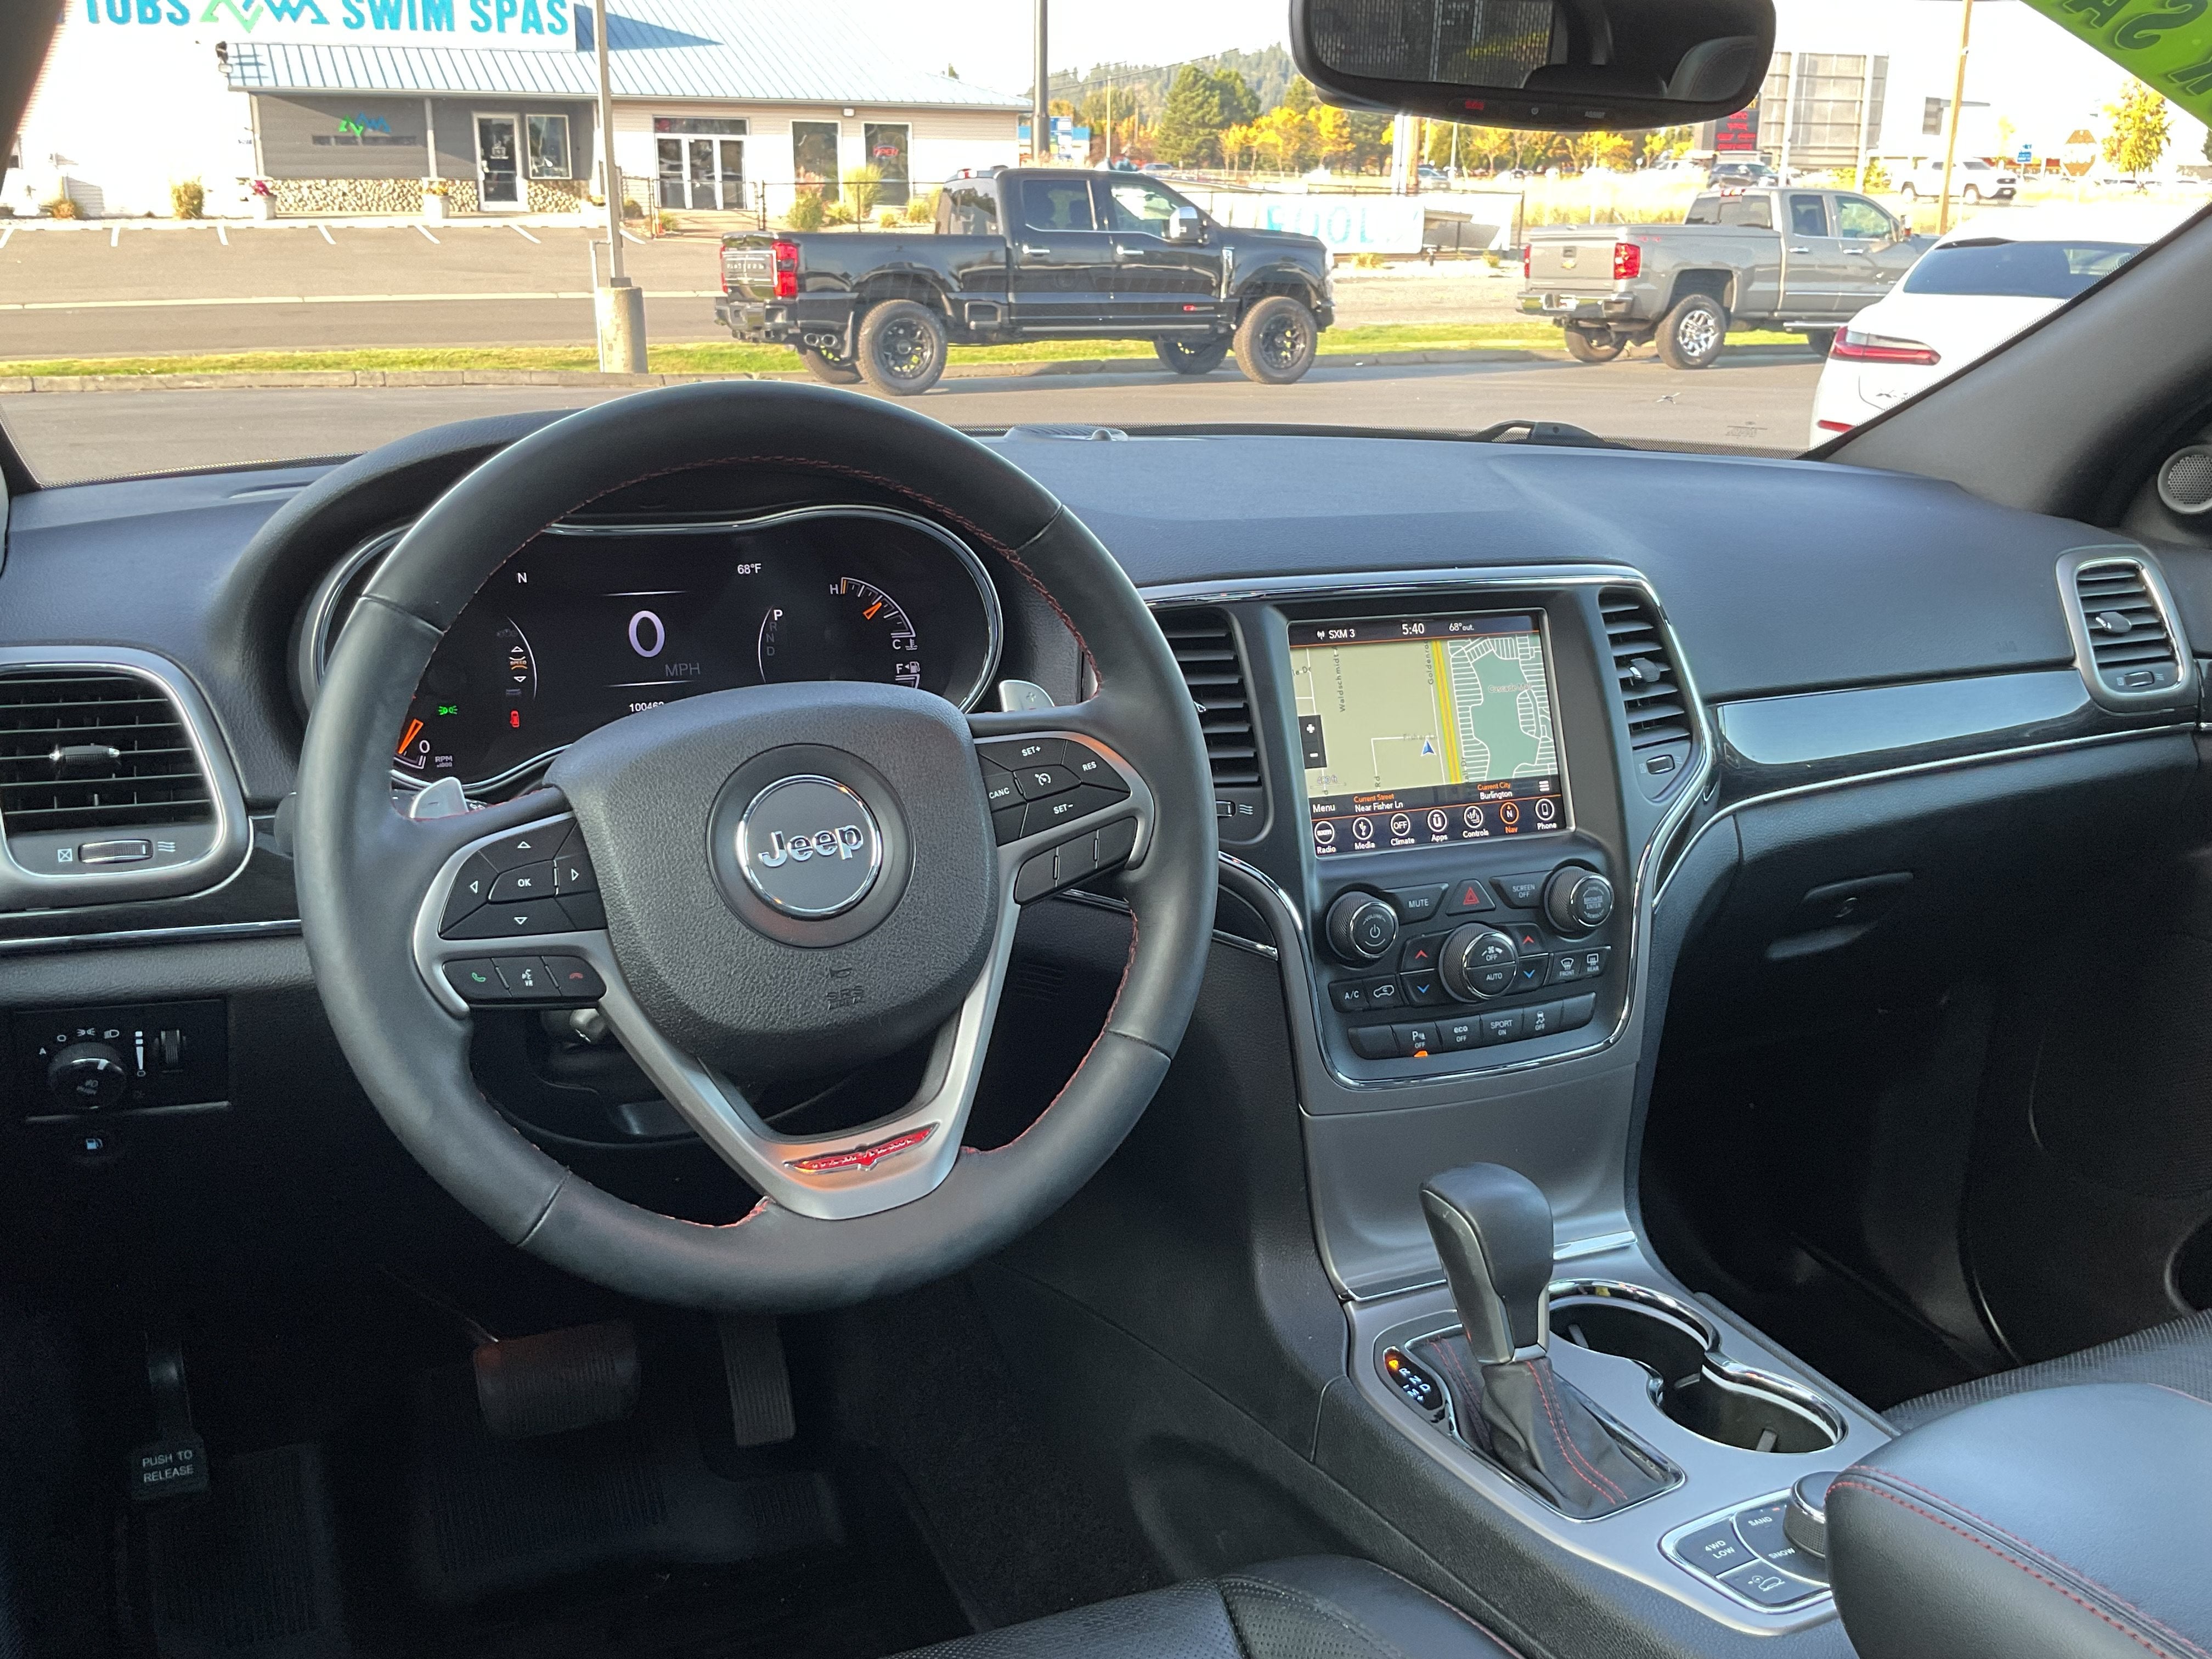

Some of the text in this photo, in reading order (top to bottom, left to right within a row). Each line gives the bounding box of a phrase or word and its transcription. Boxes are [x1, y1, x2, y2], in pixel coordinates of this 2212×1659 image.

[342, 0, 568, 35] SWIM SPAS
[737, 563, 761, 574] 68°F
[517, 572, 527, 583] N
[830, 584, 839, 595] H
[773, 609, 783, 621] P
[769, 622, 777, 631] R
[1402, 622, 1425, 635] 5:40
[629, 610, 665, 658] 0
[766, 633, 775, 643] N
[1329, 628, 1356, 639] SXM 3
[892, 639, 901, 650] C
[767, 646, 775, 656] D
[665, 662, 700, 676] MPH
[895, 663, 904, 674] F
[1488, 684, 1517, 693] Cascade
[419, 740, 430, 753] 0
[1082, 761, 1097, 772] RES
[1477, 781, 1511, 791] Current City
[989, 787, 1010, 799] CANC
[1480, 791, 1513, 800] Burlington
[1353, 795, 1376, 803] Current
[1312, 804, 1335, 813] Menu
[1355, 804, 1372, 812] Near
[1373, 802, 1393, 811] Fisher
[1393, 821, 1408, 830] OFF
[1537, 822, 1557, 830] Phone
[1431, 833, 1448, 843] Apps
[1463, 829, 1489, 838] Controls
[758, 825, 864, 868] Jeep
[1355, 841, 1375, 850] Media
[1390, 837, 1415, 847] Climate
[1317, 846, 1336, 855] Radio
[517, 878, 532, 888] OK
[1512, 884, 1536, 893] SCREEN
[1518, 890, 1531, 899] OFF
[1408, 898, 1429, 909] MUTE
[1486, 953, 1498, 961] OFF
[1486, 972, 1503, 981] AUTO
[1344, 990, 1359, 1000] A/C
[1454, 1025, 1469, 1034] eco
[1490, 1019, 1513, 1030] SPORT
[1419, 1383, 1431, 1392] D
[142, 1449, 193, 1468] PUSH TO
[143, 1464, 194, 1483] RELEASE
[1748, 1516, 1773, 1527] SAND
[1705, 1540, 1726, 1552] 4WD
[1713, 1547, 1735, 1559] LOW
[1768, 1547, 1796, 1559] SNOW
